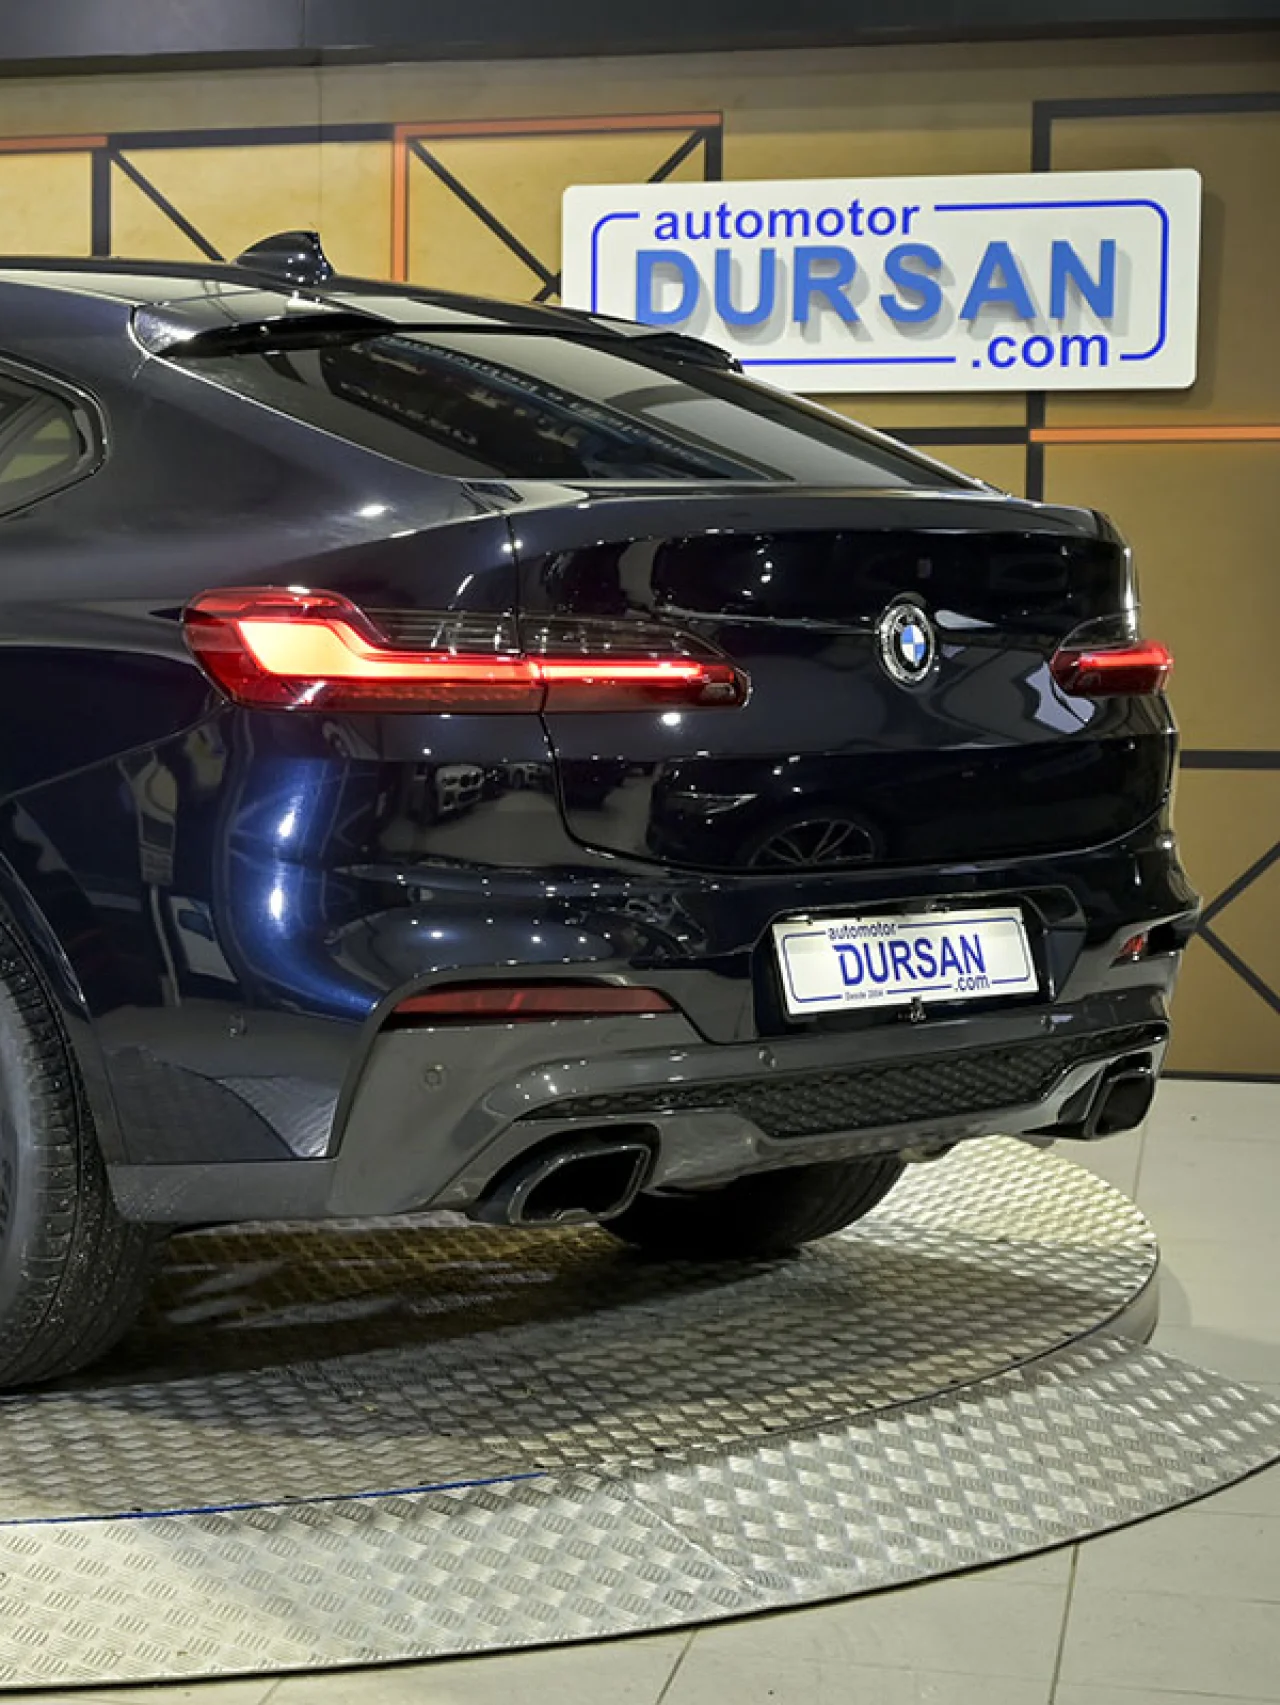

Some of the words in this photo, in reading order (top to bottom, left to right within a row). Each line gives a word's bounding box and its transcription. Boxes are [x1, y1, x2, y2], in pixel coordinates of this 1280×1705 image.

[655, 200, 920, 240] automotor
[636, 239, 1116, 325] DURSAN
[972, 334, 1109, 369] .com
[829, 922, 897, 940] automotor
[833, 934, 986, 986] DURSAN
[955, 974, 991, 992] .com
